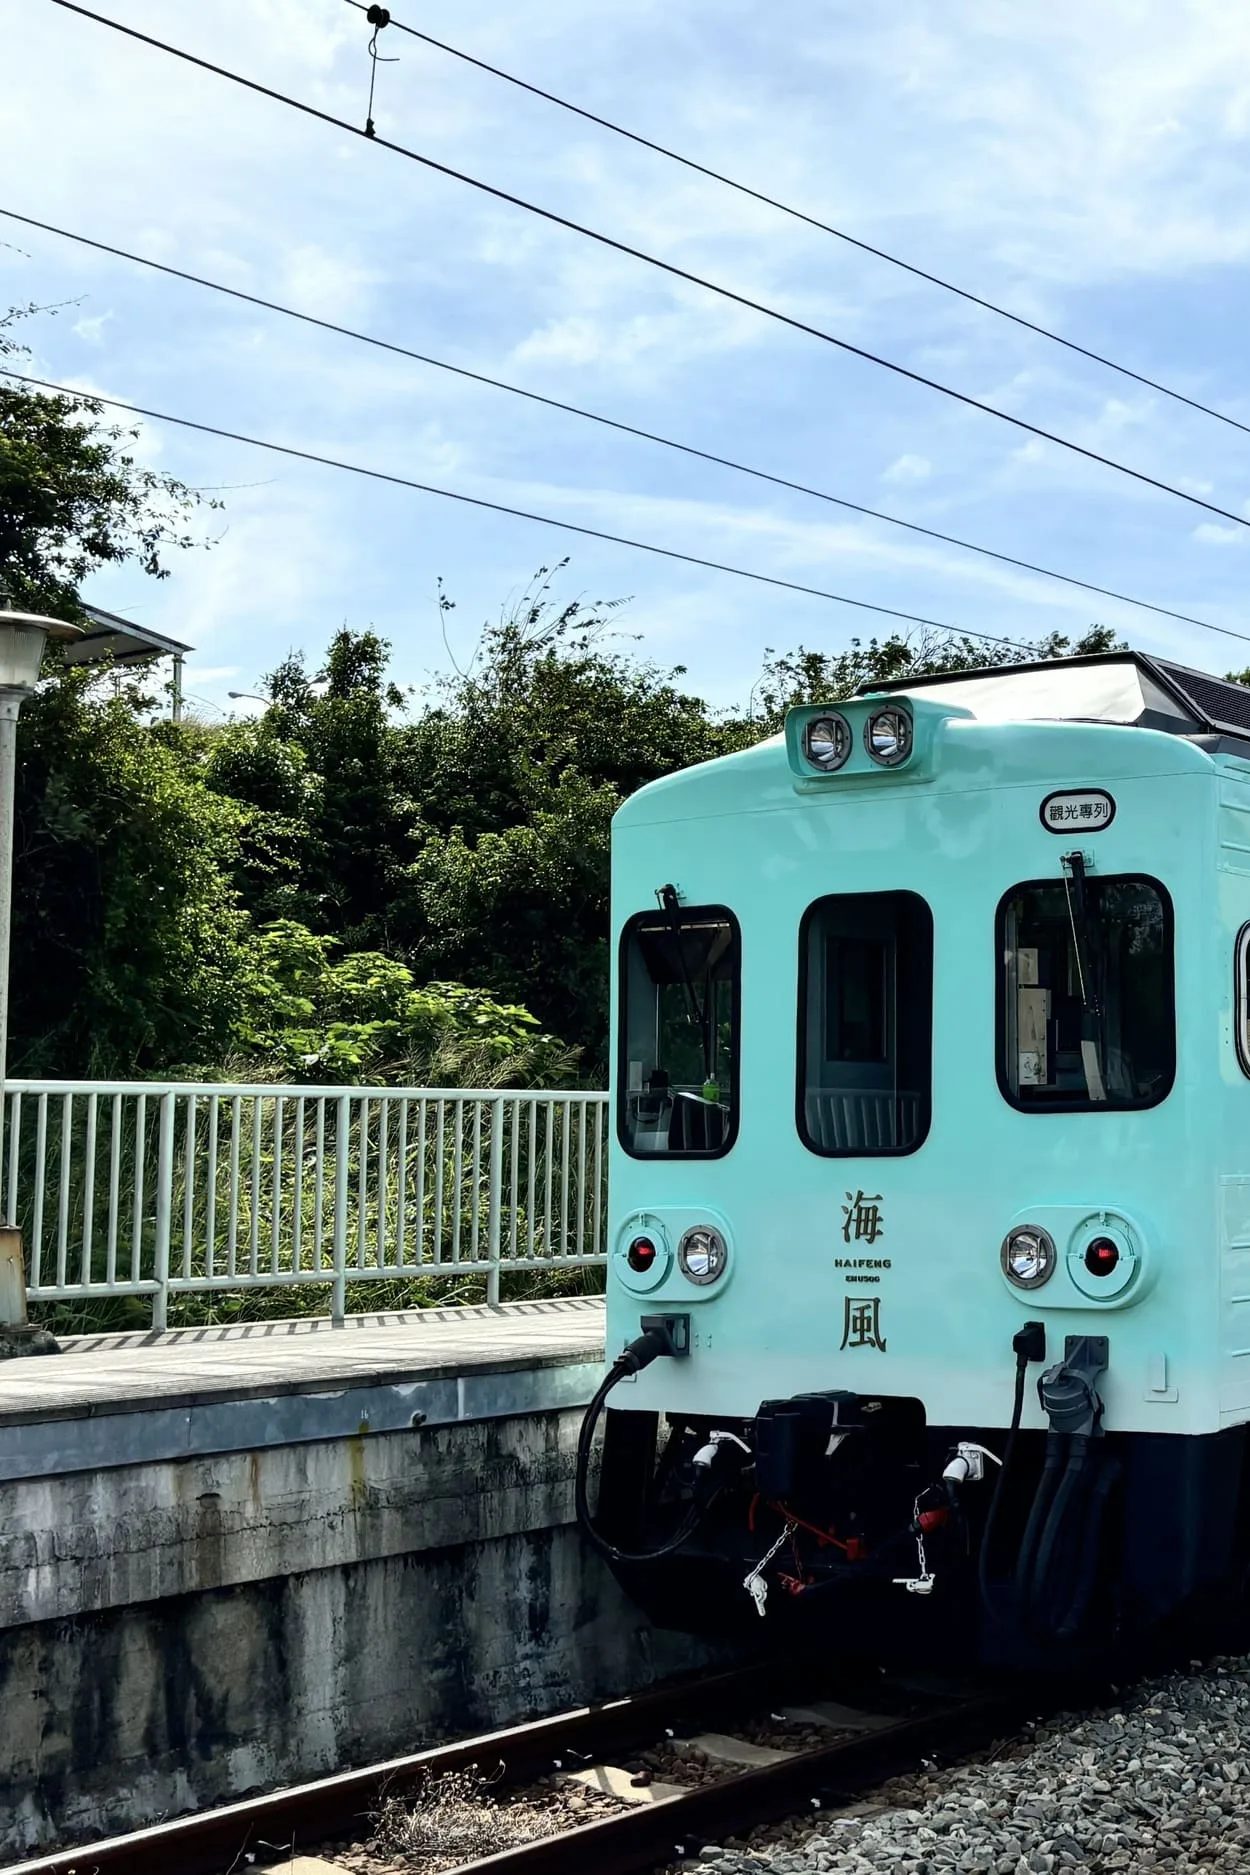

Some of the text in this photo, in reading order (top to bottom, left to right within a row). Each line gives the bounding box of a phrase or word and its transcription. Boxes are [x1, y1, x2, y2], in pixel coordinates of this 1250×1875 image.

[1049, 802, 1108, 820] 觀光專列
[841, 1190, 884, 1244] 海
[834, 1258, 892, 1269] HAIFENG
[840, 1296, 887, 1352] 風
